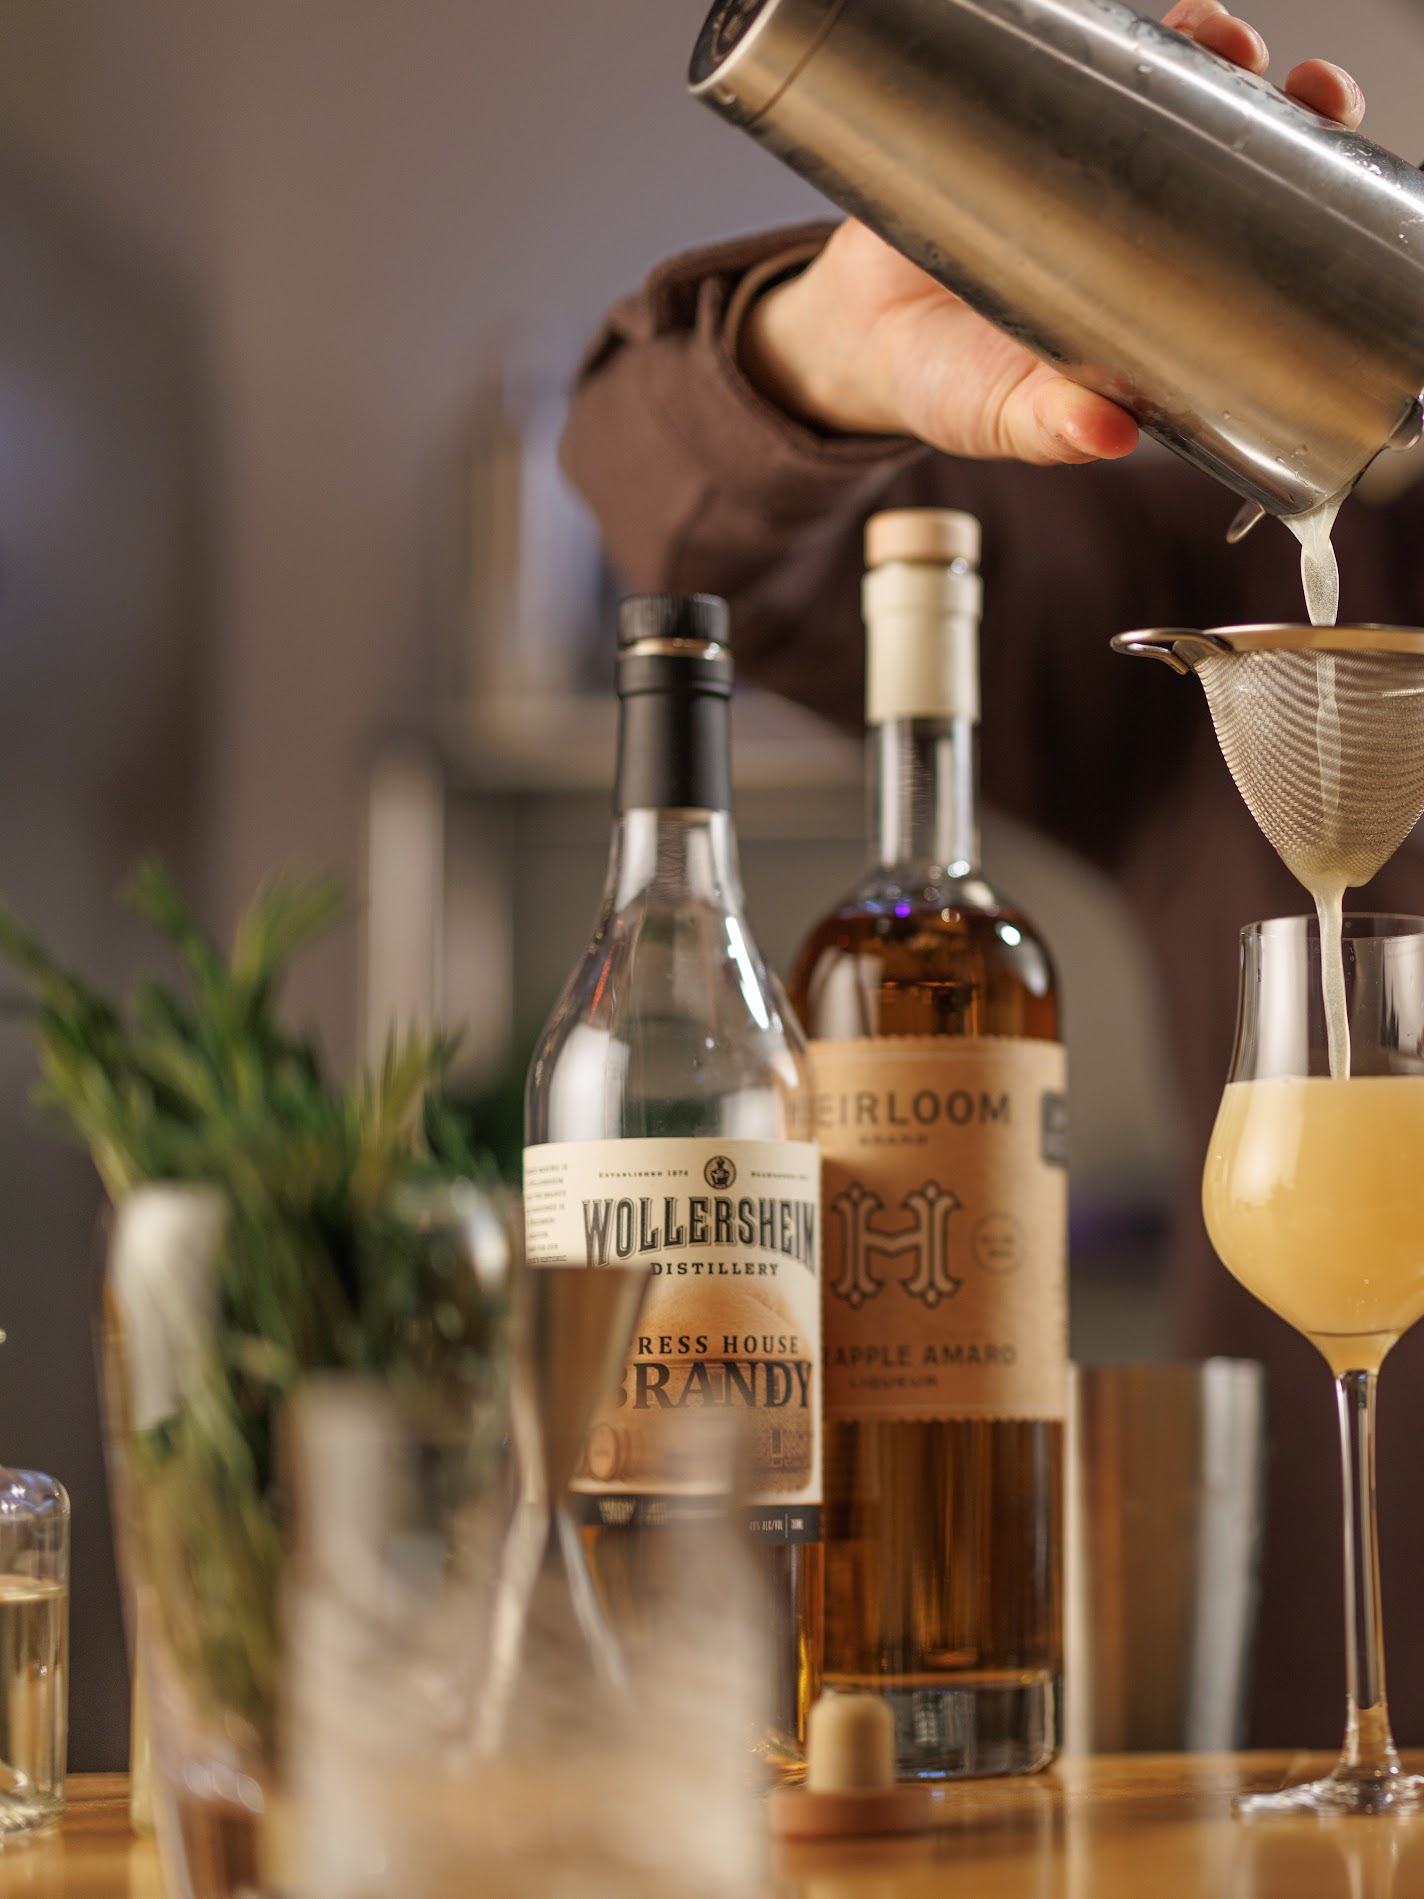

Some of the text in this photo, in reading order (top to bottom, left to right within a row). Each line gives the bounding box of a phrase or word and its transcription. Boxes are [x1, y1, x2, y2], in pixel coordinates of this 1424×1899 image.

[651, 1262, 779, 1275] DISTILLERY
[638, 1335, 799, 1355] RESS HOUSE
[924, 1344, 1018, 1367] AMARO
